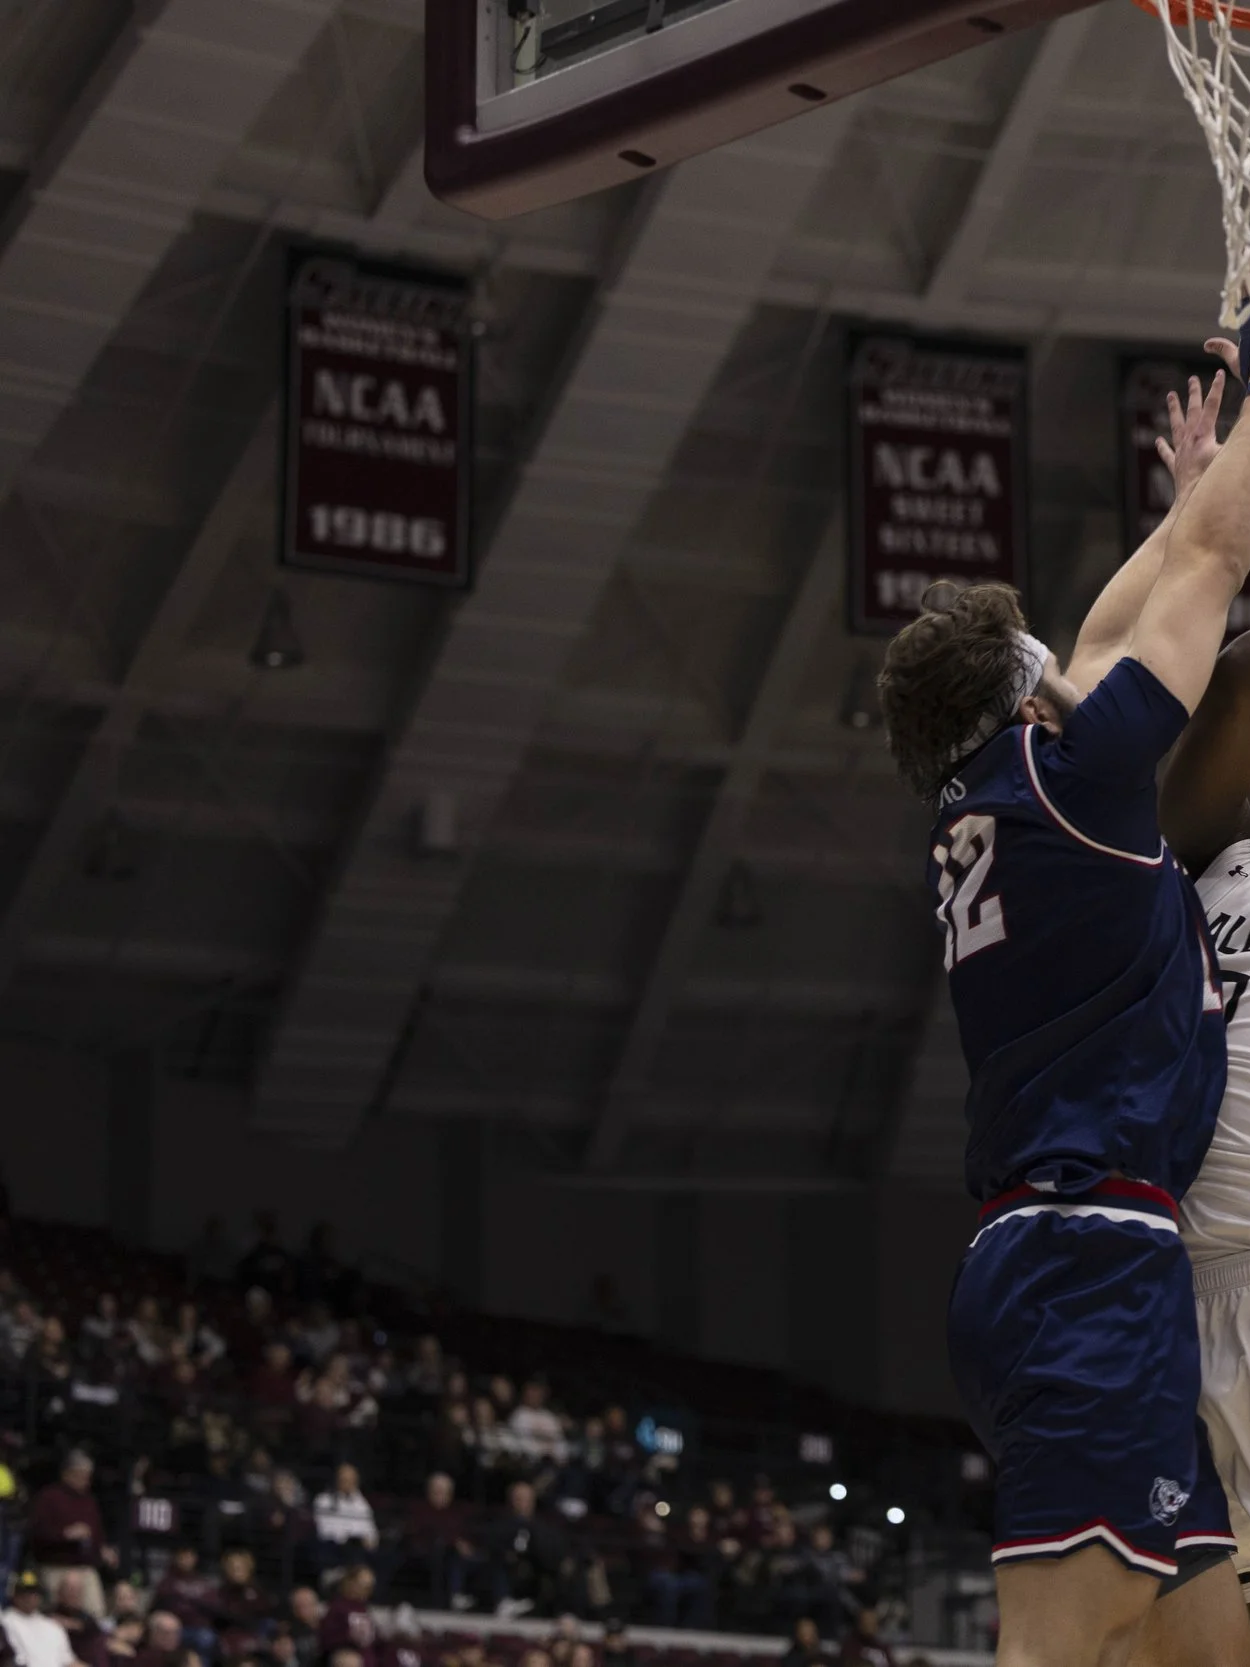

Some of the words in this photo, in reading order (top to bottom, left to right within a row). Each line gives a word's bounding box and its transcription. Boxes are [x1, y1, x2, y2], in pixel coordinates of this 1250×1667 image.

[312, 368, 446, 433] NCAA
[301, 418, 456, 468] TOURNAMENT
[872, 441, 1002, 498] NCAA
[308, 503, 446, 559] 1986
[890, 493, 985, 526] SWEET
[878, 521, 999, 562] SIXTEEN
[932, 813, 1008, 973] 12
